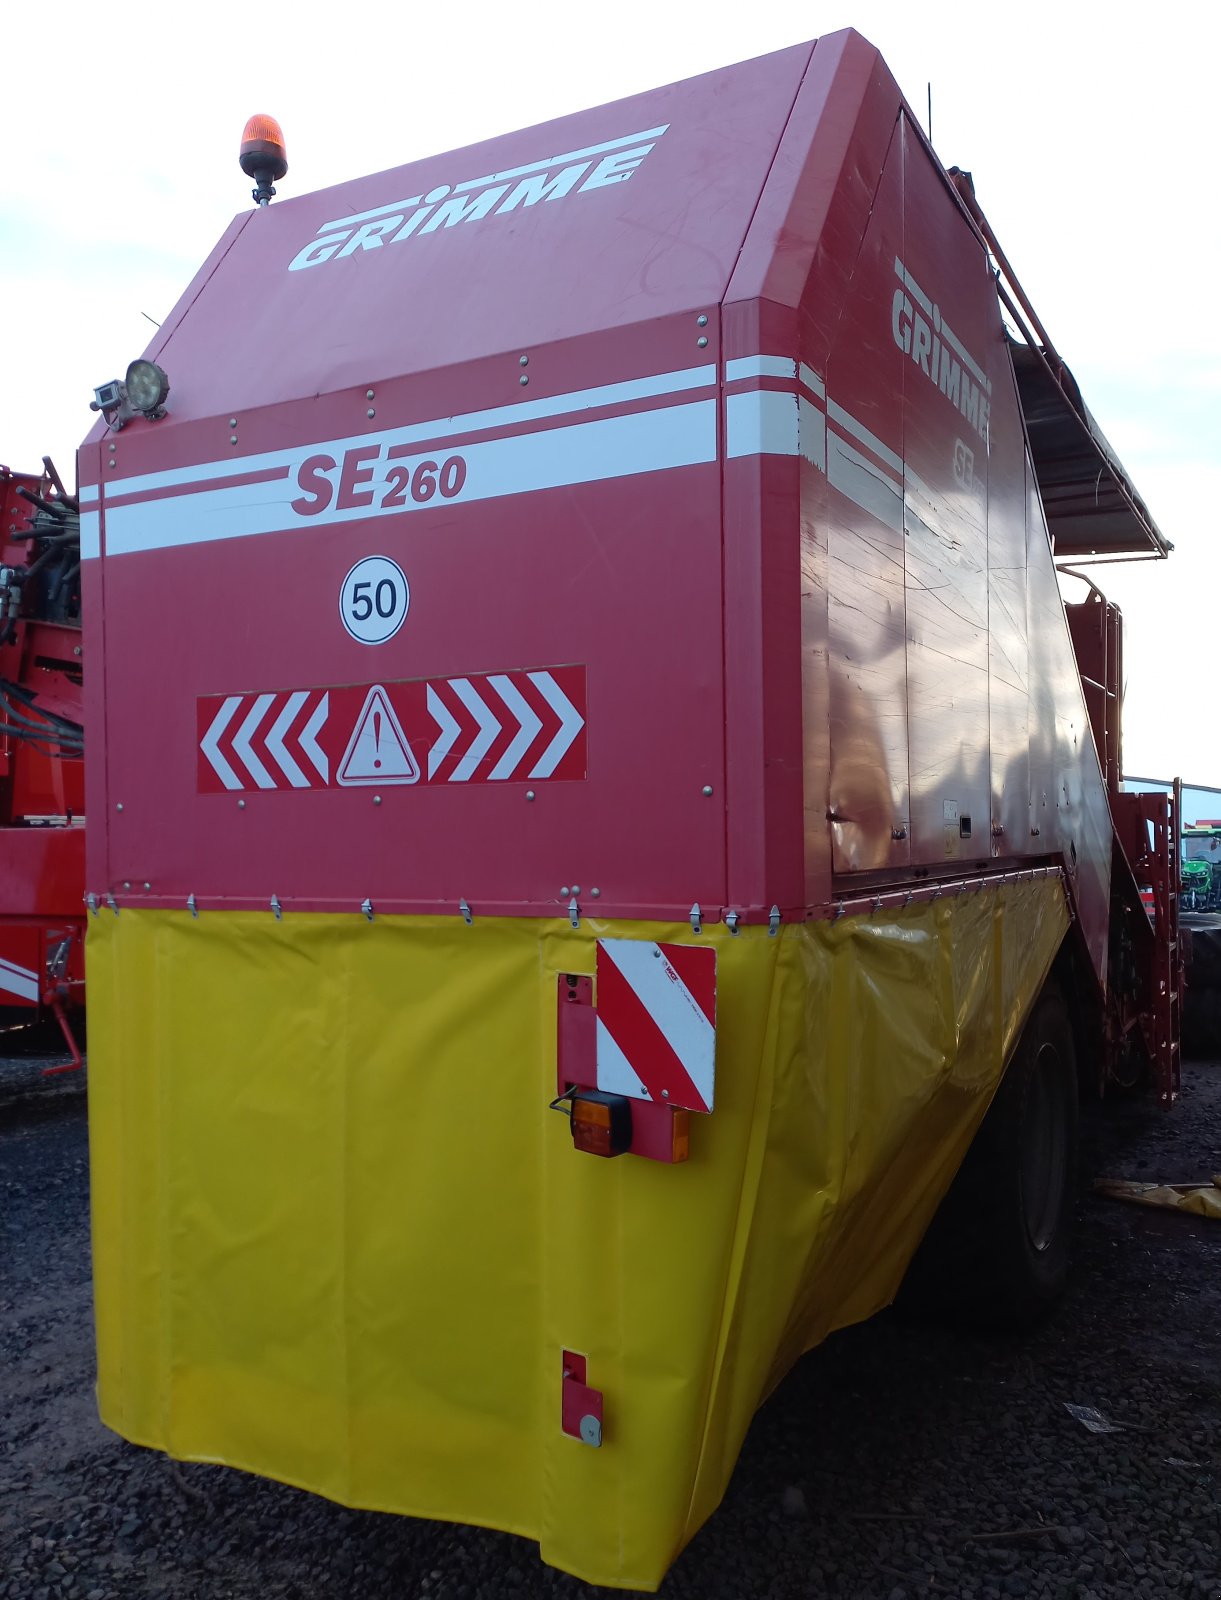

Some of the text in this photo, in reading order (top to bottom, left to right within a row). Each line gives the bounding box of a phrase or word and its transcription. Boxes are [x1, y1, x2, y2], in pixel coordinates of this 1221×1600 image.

[287, 142, 656, 272] GRIMME
[892, 288, 991, 444] GRIMME
[290, 443, 467, 516] SE 260
[351, 578, 397, 621] 50
